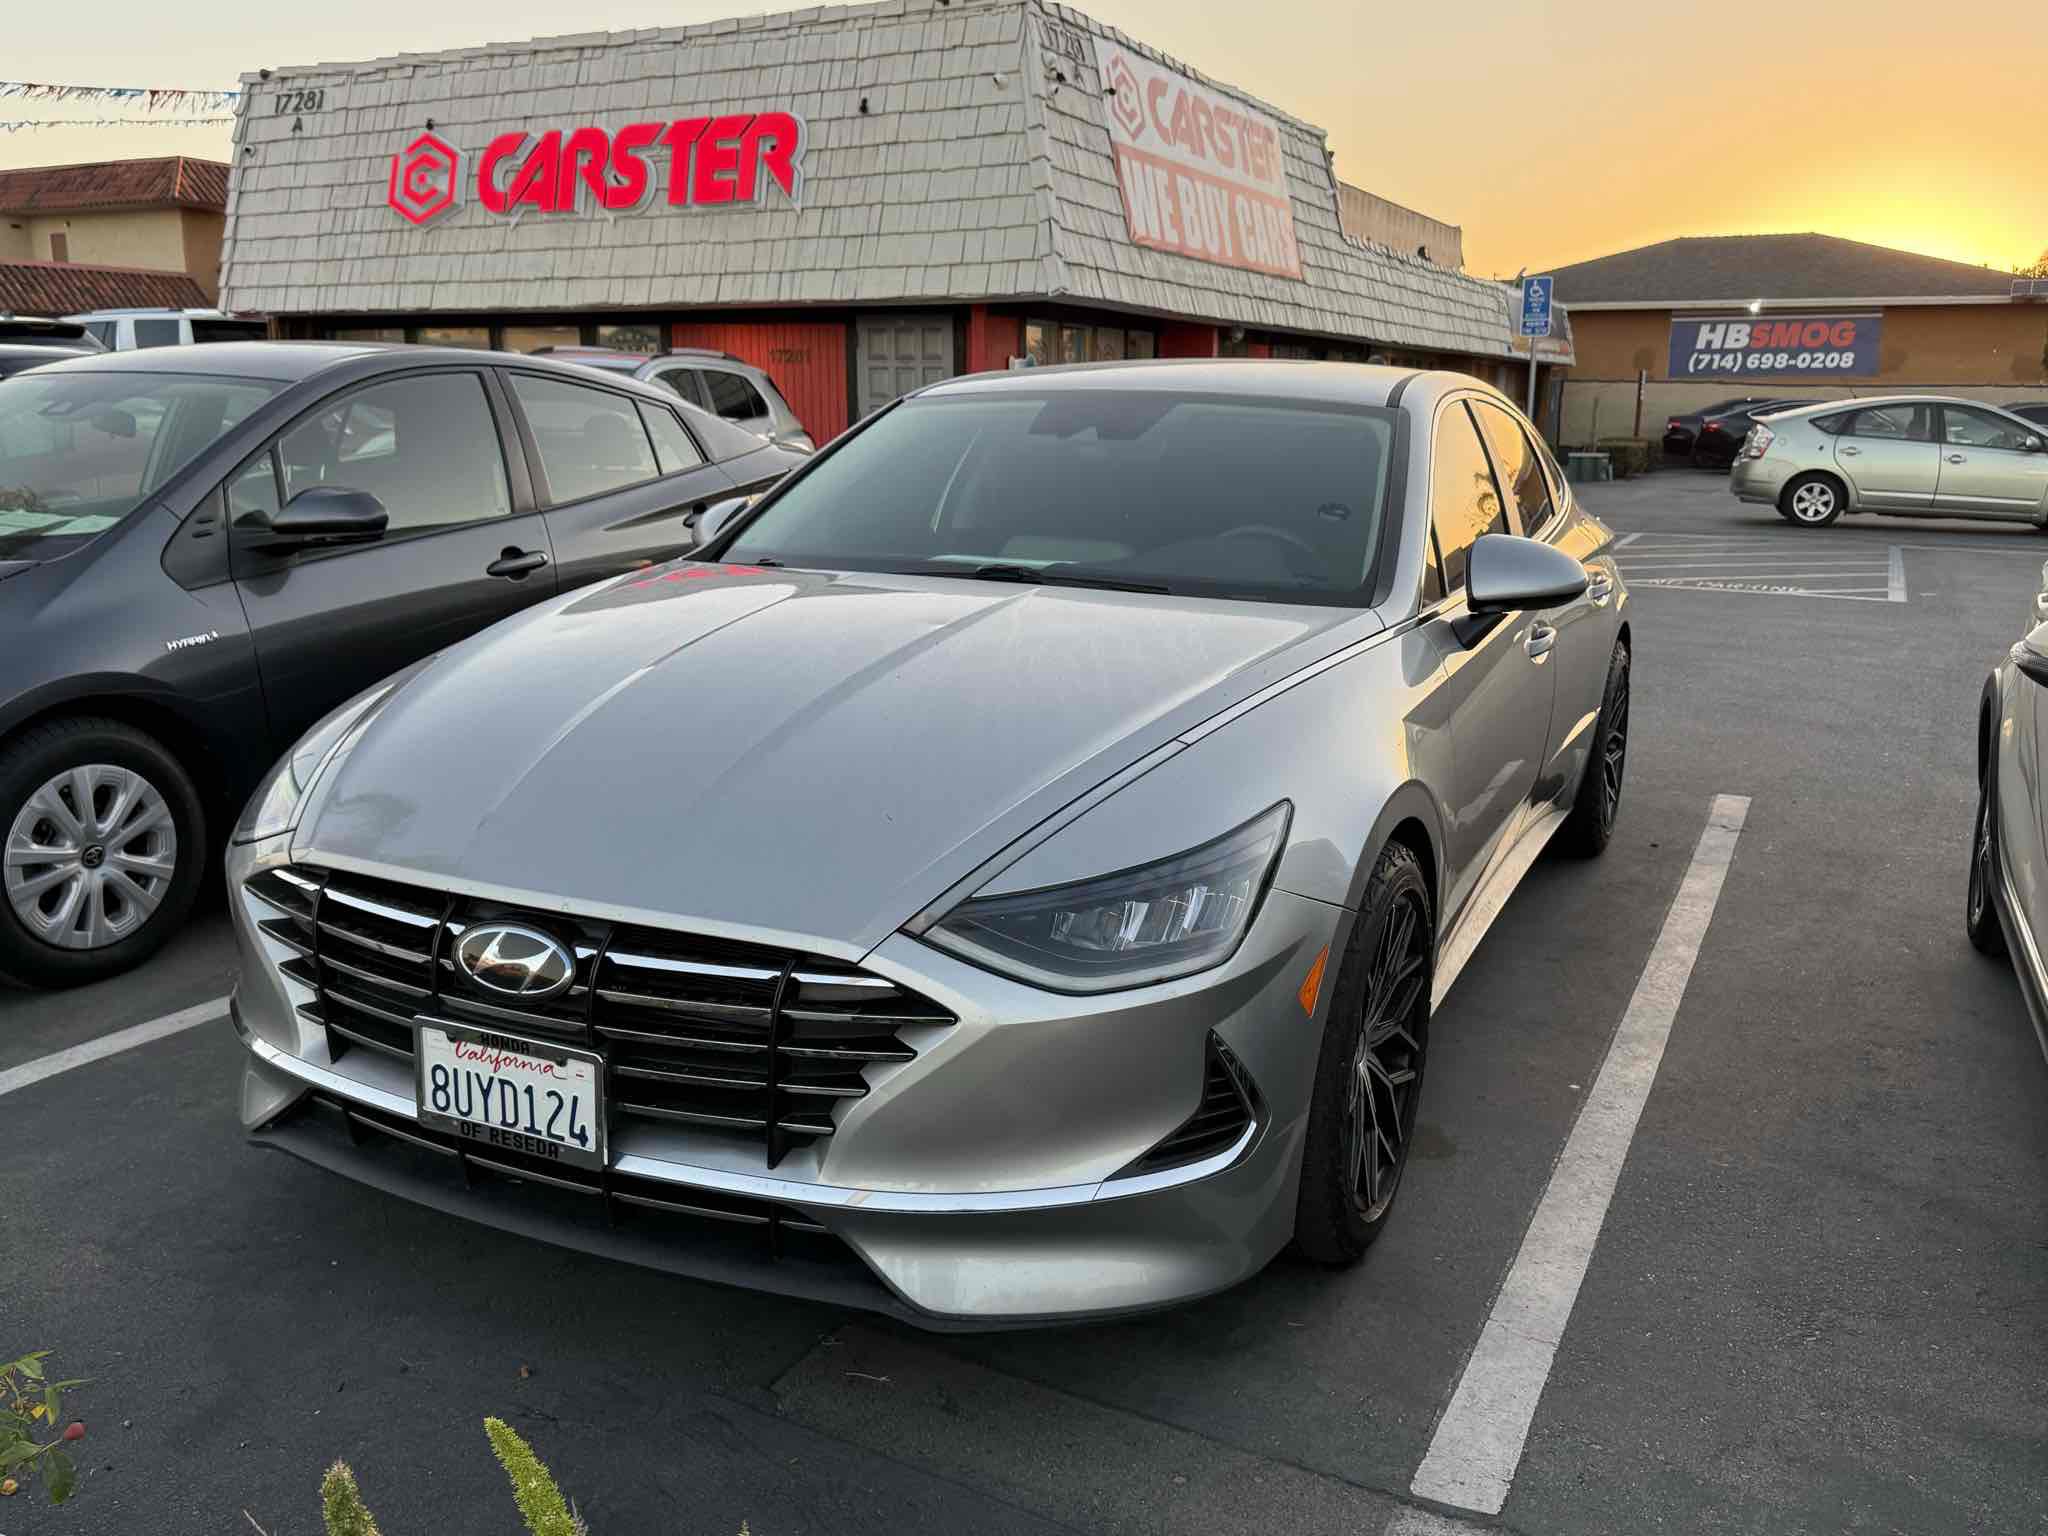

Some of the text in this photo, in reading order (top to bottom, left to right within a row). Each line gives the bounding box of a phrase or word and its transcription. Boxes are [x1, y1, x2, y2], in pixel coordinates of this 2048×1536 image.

[275, 89, 324, 113] 17281
[1147, 76, 1276, 184] CARSTER
[477, 111, 799, 216] CARSTER
[1121, 153, 1300, 272] WE BUY CARS
[1688, 351, 1855, 372] (714) 698-0208
[454, 1040, 568, 1080] California
[431, 1063, 589, 1147] 8UYD124
[460, 1121, 559, 1160] OF RESEDA
